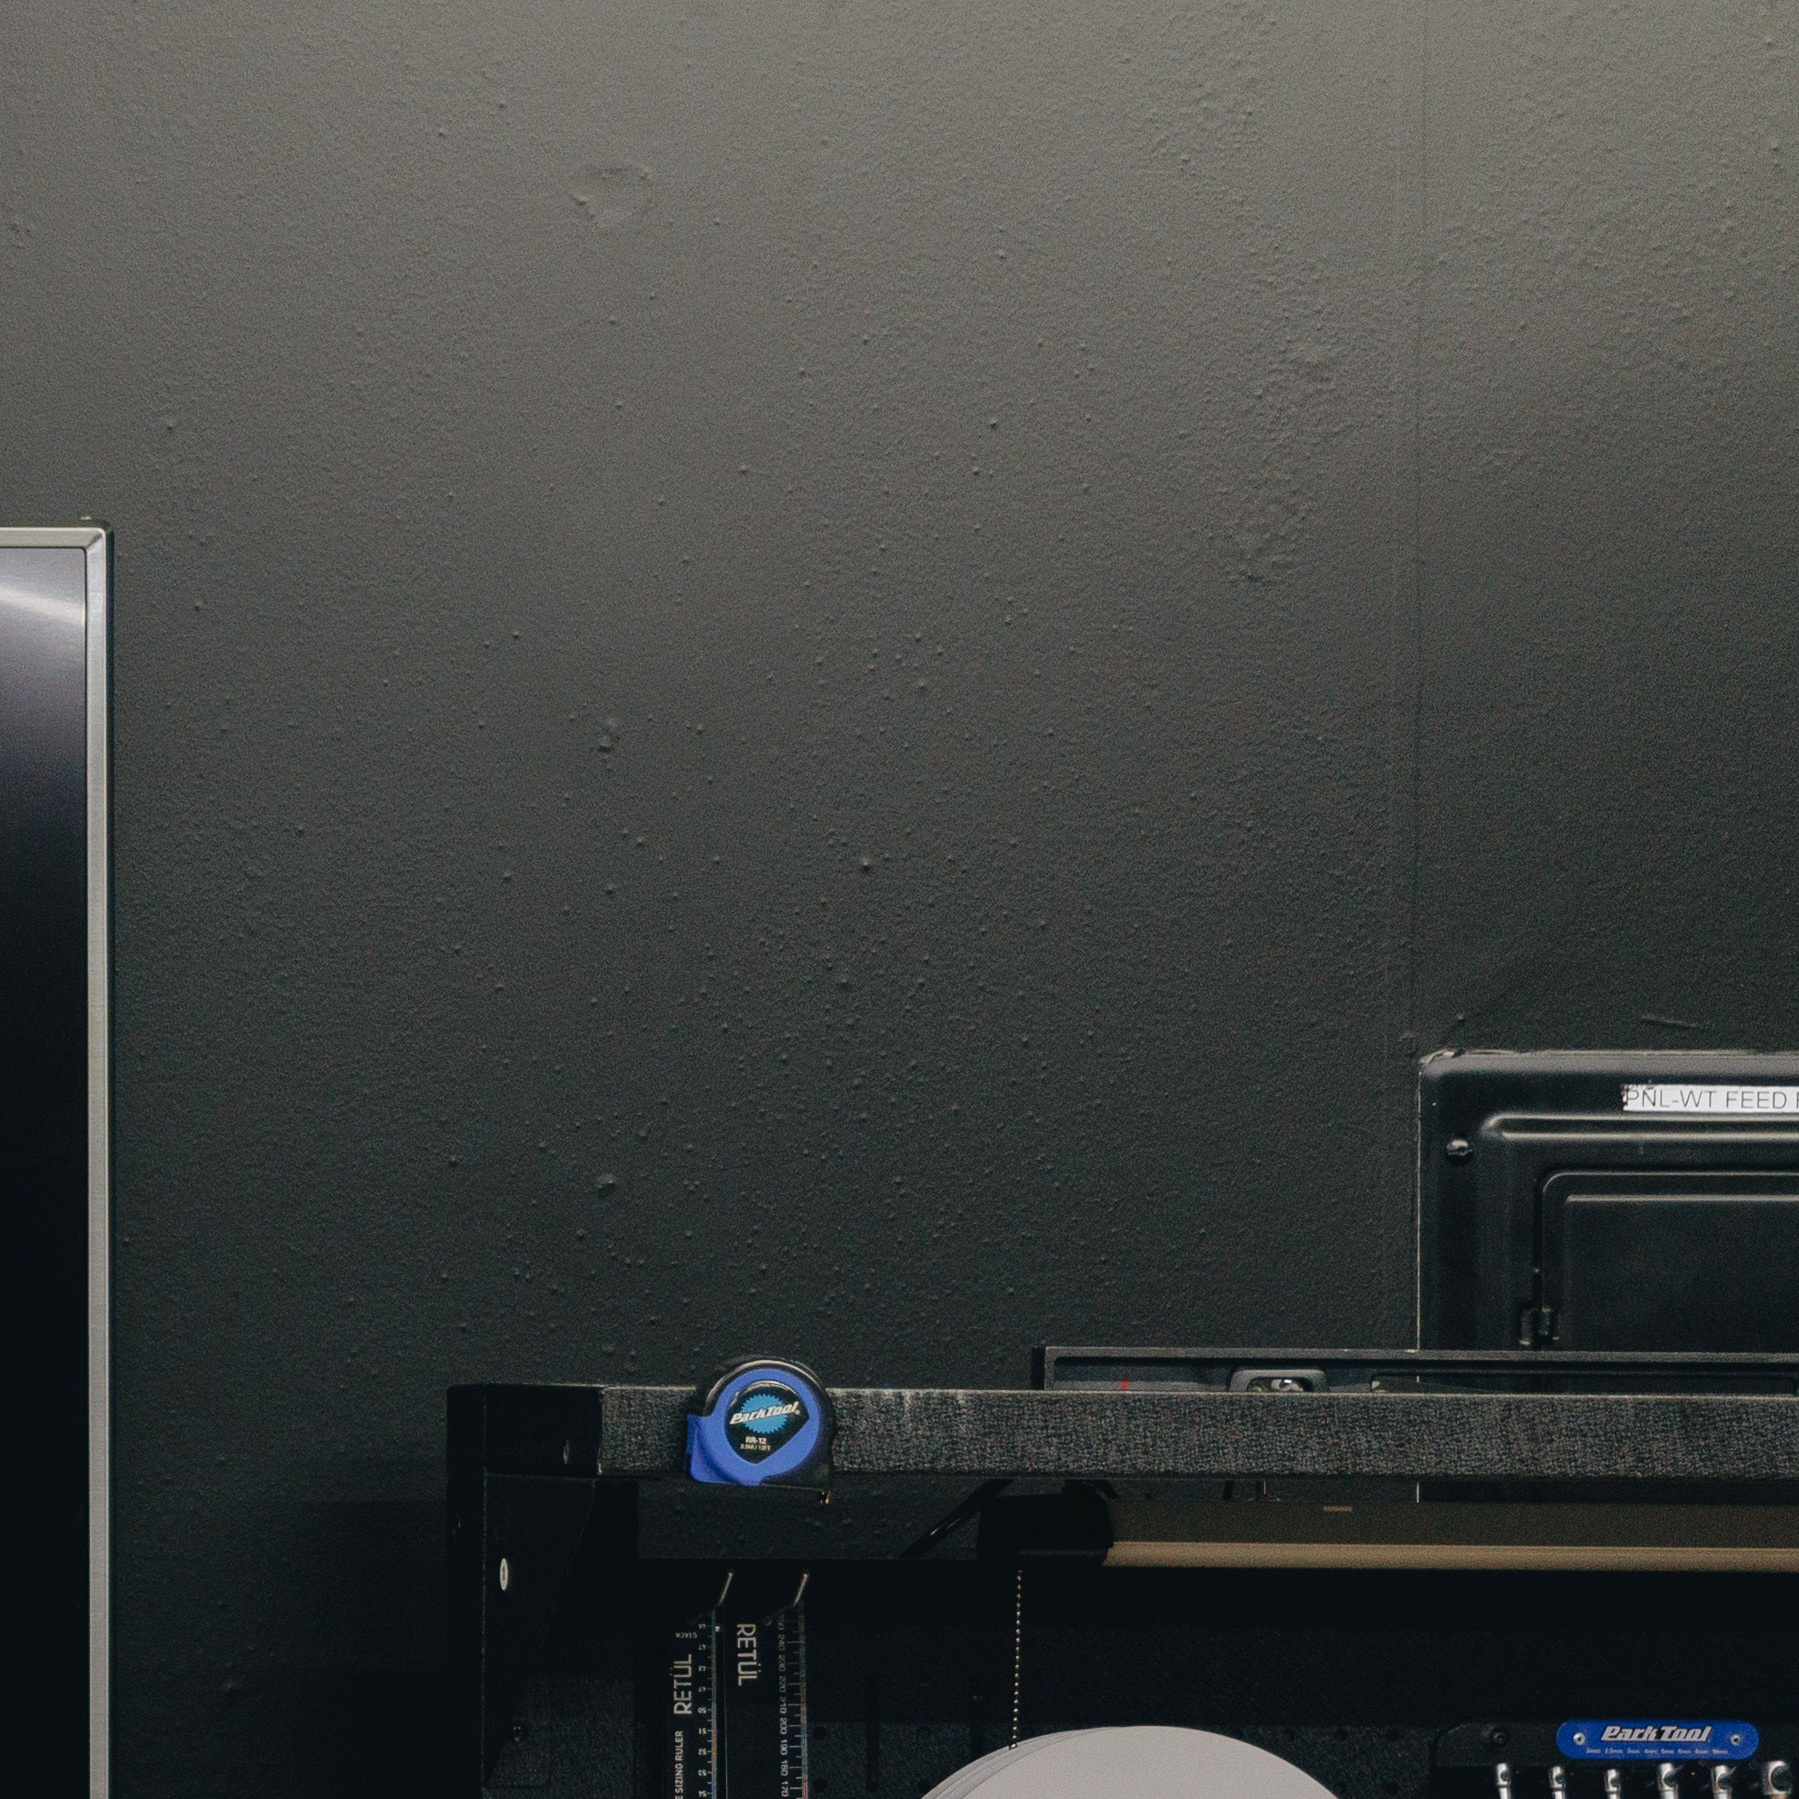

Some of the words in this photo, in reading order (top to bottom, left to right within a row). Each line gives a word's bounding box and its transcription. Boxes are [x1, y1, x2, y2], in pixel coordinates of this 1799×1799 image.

[1626, 1090, 1717, 1108] PNL-WT
[1726, 1090, 1788, 1110] FEED
[736, 1623, 762, 1687] RETÜL
[669, 1653, 692, 1715] RETÜL
[674, 1730, 684, 1761] RULER
